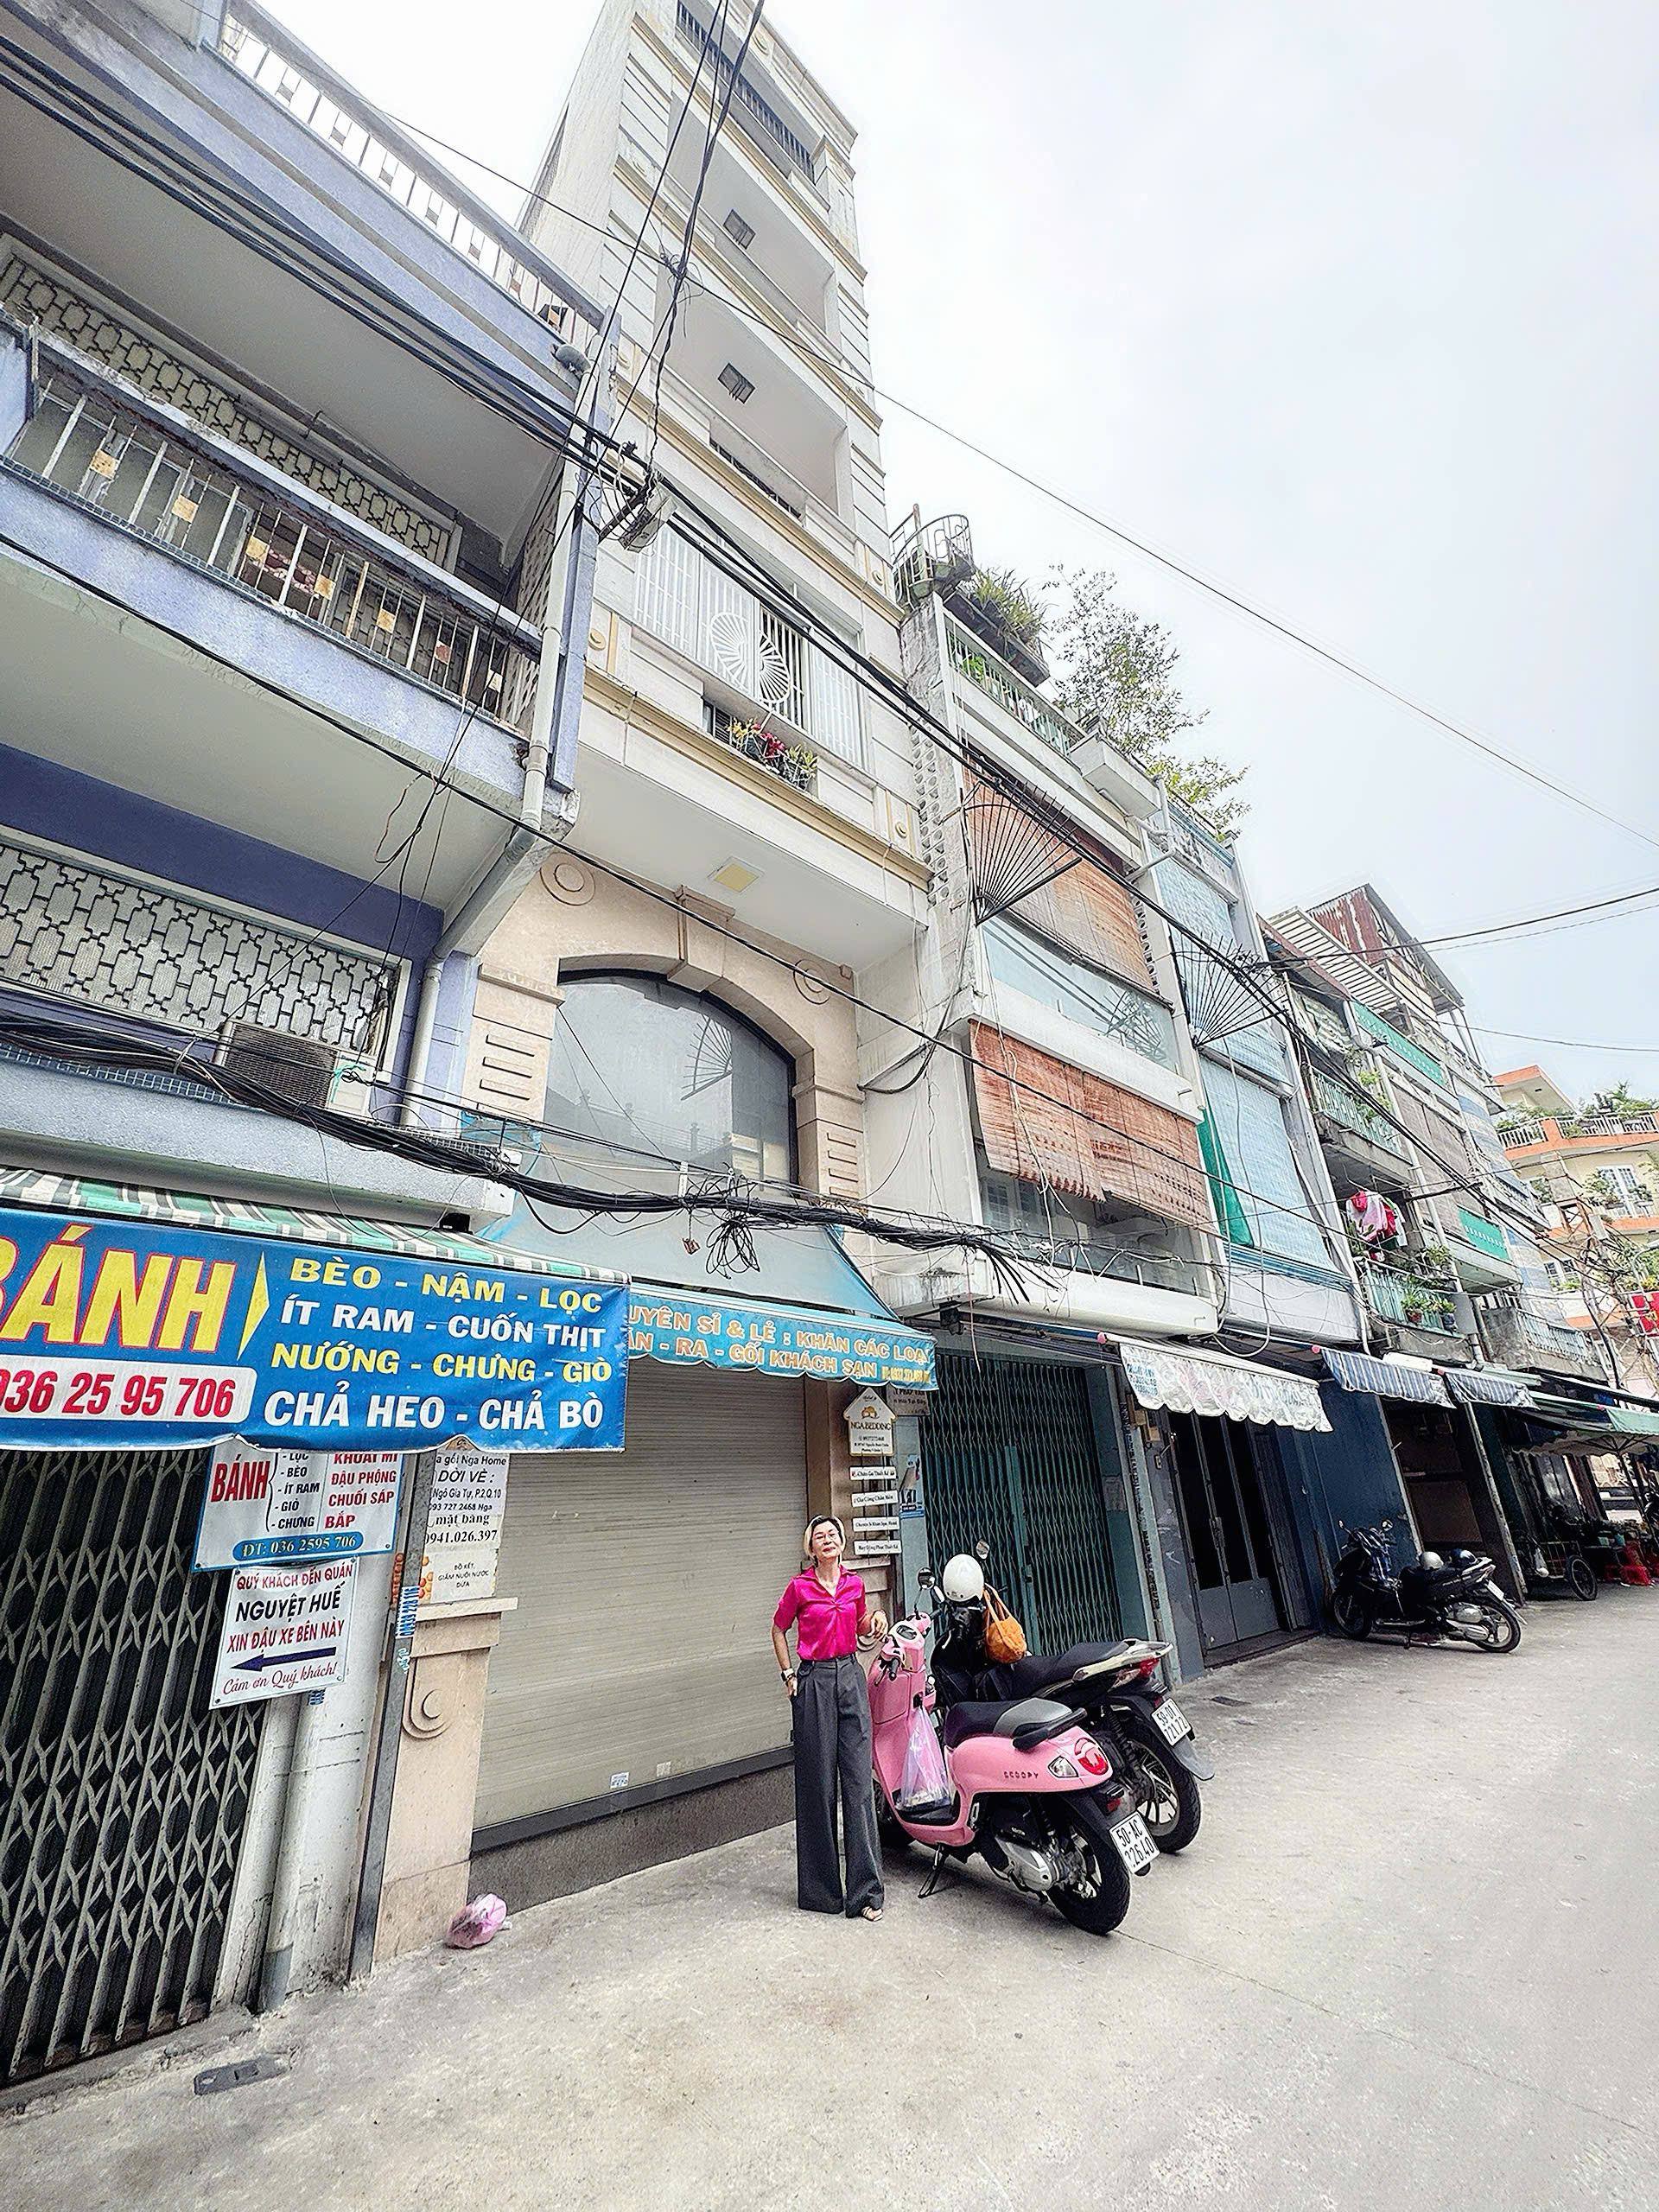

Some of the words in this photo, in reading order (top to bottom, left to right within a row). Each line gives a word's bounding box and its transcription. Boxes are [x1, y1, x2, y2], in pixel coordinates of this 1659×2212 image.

[290, 1255, 381, 1289] BÈO
[422, 1271, 505, 1303] NẬM
[539, 1287, 603, 1314] LỌC
[281, 1293, 321, 1325] ÍT
[332, 1304, 415, 1333] RAM
[448, 1312, 533, 1343] CUỐN
[543, 1323, 606, 1352] THỊT
[727, 1320, 745, 1338] &
[749, 1320, 776, 1344] LẺ
[797, 1331, 849, 1353] KHĂN
[854, 1338, 890, 1359] CÁC
[271, 1340, 400, 1374] NƯỚNG
[433, 1353, 536, 1382] CHƯNG
[563, 1356, 612, 1383] GIÒ
[676, 1337, 709, 1358] RA
[729, 1341, 765, 1364] GỐI
[770, 1350, 837, 1374] KHÁCH
[842, 1359, 877, 1379] SẠN
[61, 1372, 115, 1414] 25
[120, 1375, 168, 1416] 95
[174, 1377, 236, 1418] 706
[264, 1380, 349, 1427] CHẢ
[366, 1395, 445, 1429] HEO
[479, 1389, 545, 1430] CHẢ
[559, 1391, 604, 1428] BÒ
[444, 1452, 459, 1465] gối
[461, 1455, 479, 1466] Nga
[481, 1456, 506, 1465] Home
[211, 1453, 270, 1503] BÁNH
[287, 1465, 308, 1478] BÈO
[331, 1471, 355, 1488] ĐẬU
[359, 1469, 397, 1486] PHỘNG
[438, 1467, 466, 1483] DỜI
[296, 1483, 320, 1494] RAM
[328, 1488, 367, 1507] CHUỐI
[370, 1489, 394, 1504] SÁP
[432, 1488, 448, 1500] Ngô
[449, 1488, 461, 1498] Gia
[478, 1503, 493, 1512] Nga
[278, 1516, 315, 1529] CHƯNG
[325, 1510, 355, 1529] BẮP
[435, 1514, 458, 1527] mặt
[242, 1543, 265, 1557] ĐT:
[270, 1541, 294, 1554] 036
[298, 1537, 330, 1551] 2595
[335, 1535, 356, 1548] 706
[237, 1575, 259, 1590] QUÝ
[262, 1572, 298, 1589] KHÁCH
[302, 1569, 321, 1586] ĐẾN
[325, 1563, 353, 1580] QUÁN
[236, 1592, 307, 1623] NGUYỆT
[309, 1581, 345, 1613] HUẾ
[226, 1633, 248, 1653] XIN
[251, 1626, 276, 1652] ĐẬU
[278, 1629, 293, 1645] XE
[296, 1620, 318, 1643] BÊN
[321, 1616, 345, 1639] NÀY
[271, 1668, 299, 1688] Quý
[301, 1662, 338, 1682] khách!
[1003, 1770, 1039, 1779] SCOOPY
